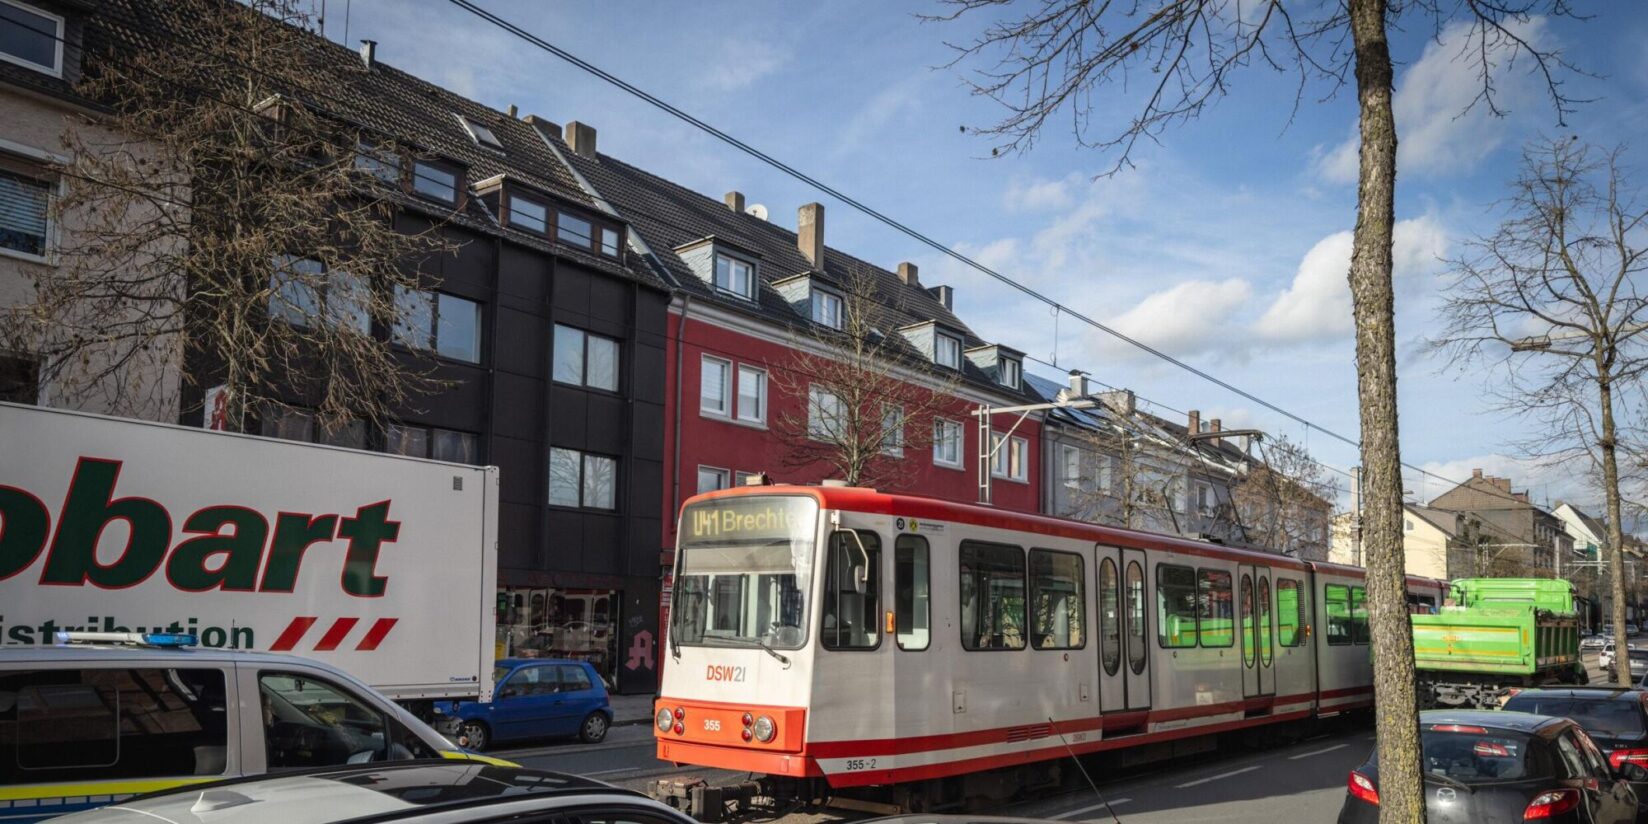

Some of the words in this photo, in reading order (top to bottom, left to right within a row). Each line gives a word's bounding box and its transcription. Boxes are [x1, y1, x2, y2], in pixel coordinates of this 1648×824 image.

[693, 510, 719, 536] U41
[722, 507, 804, 532] Brechte
[0, 615, 254, 653] stibtion
[706, 665, 746, 682] DSW21
[704, 719, 721, 731] 355
